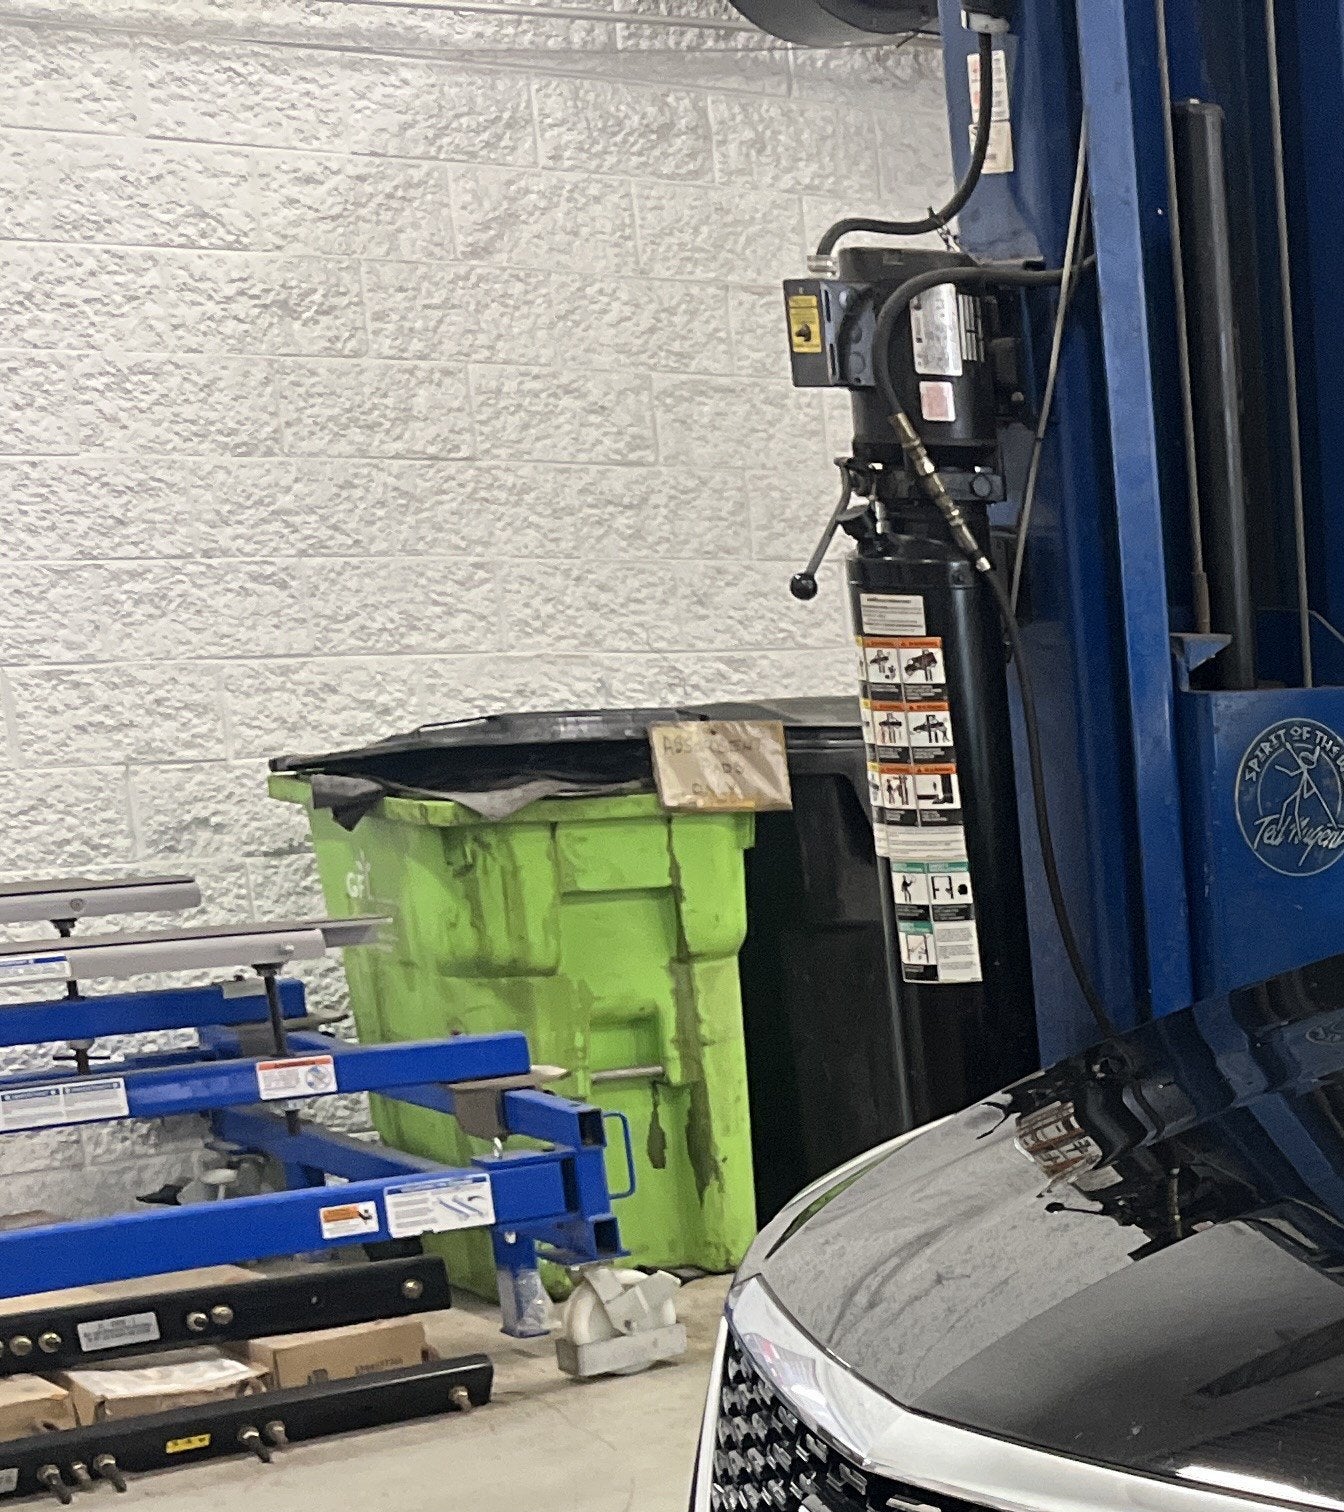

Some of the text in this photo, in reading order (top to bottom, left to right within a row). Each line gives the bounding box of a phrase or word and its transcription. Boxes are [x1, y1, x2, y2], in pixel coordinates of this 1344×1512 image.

[1245, 728, 1287, 781] SPIRIT
[1290, 725, 1311, 741] OF
[1254, 814, 1291, 849] Ted
